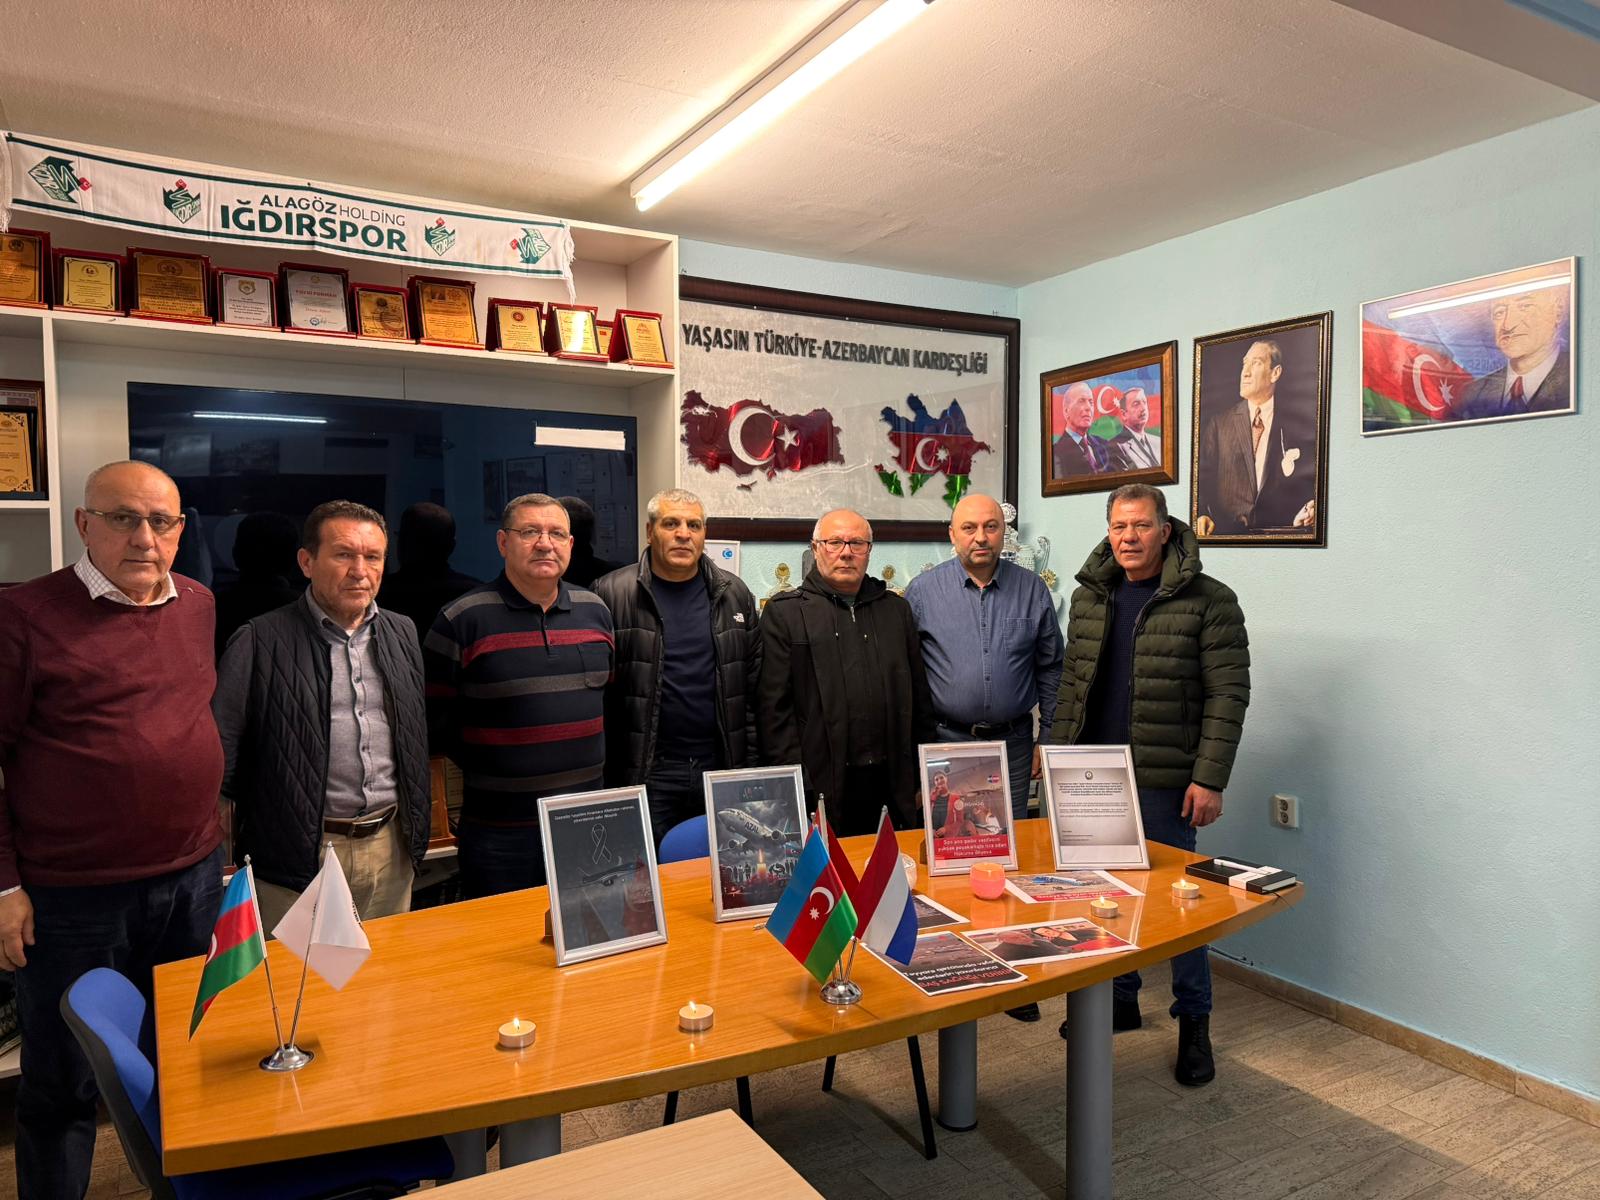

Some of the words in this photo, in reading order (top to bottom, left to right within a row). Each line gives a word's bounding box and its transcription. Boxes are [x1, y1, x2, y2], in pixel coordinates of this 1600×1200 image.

[220, 198, 408, 252] IĞDIRSPOR
[260, 194, 337, 215] ALAGÖZ
[339, 204, 406, 227] HOLDİNG
[682, 323, 749, 353] YAŞASIN
[754, 331, 910, 368] TÜRKİYE-AZERBAYCAN
[913, 349, 988, 376] KARDEŞLİĞİ
[745, 822, 759, 833] AZAL
